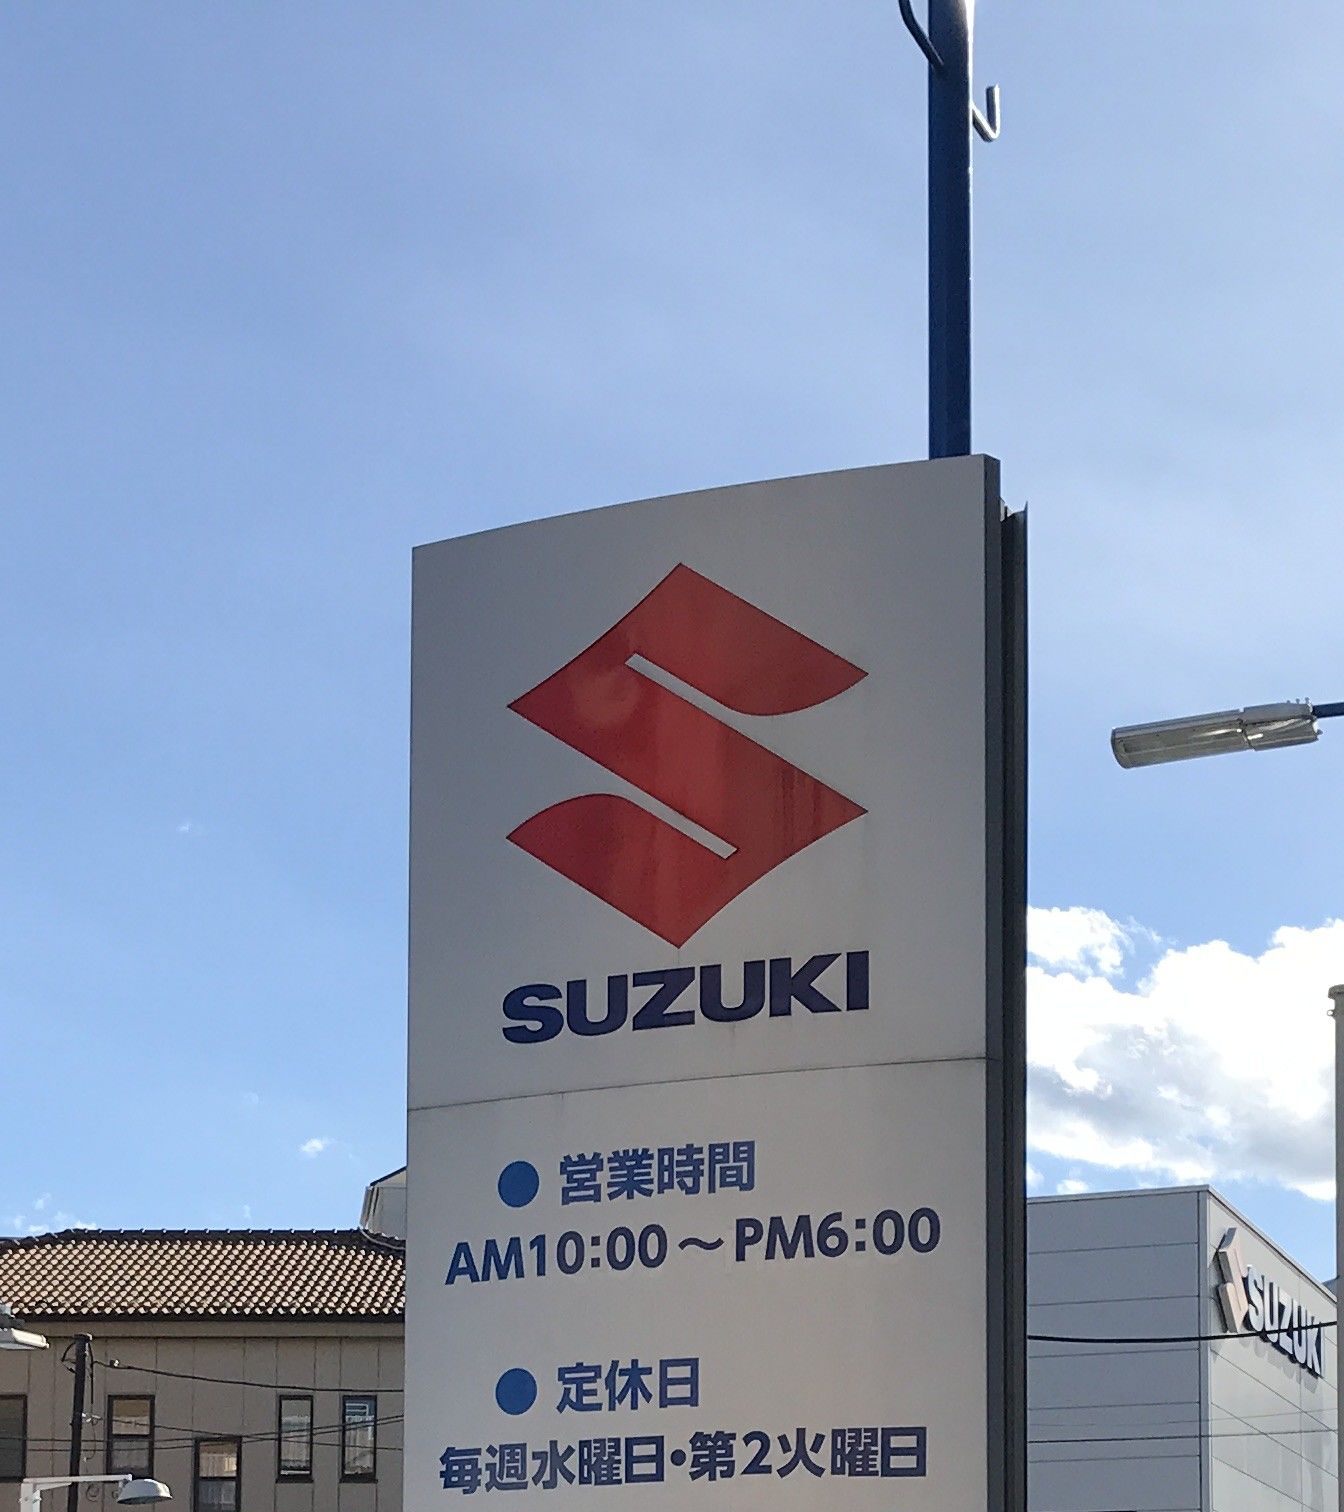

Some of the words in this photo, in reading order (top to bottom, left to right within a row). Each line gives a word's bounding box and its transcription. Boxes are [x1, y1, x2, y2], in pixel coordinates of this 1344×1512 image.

[501, 950, 870, 1045] SUZUKI
[558, 1140, 756, 1206] 営業時間
[1247, 1264, 1325, 1380] SUZUKI
[556, 1357, 701, 1414] 定休日
[438, 1426, 928, 1495] 毎週水曜日・第2火曜日
